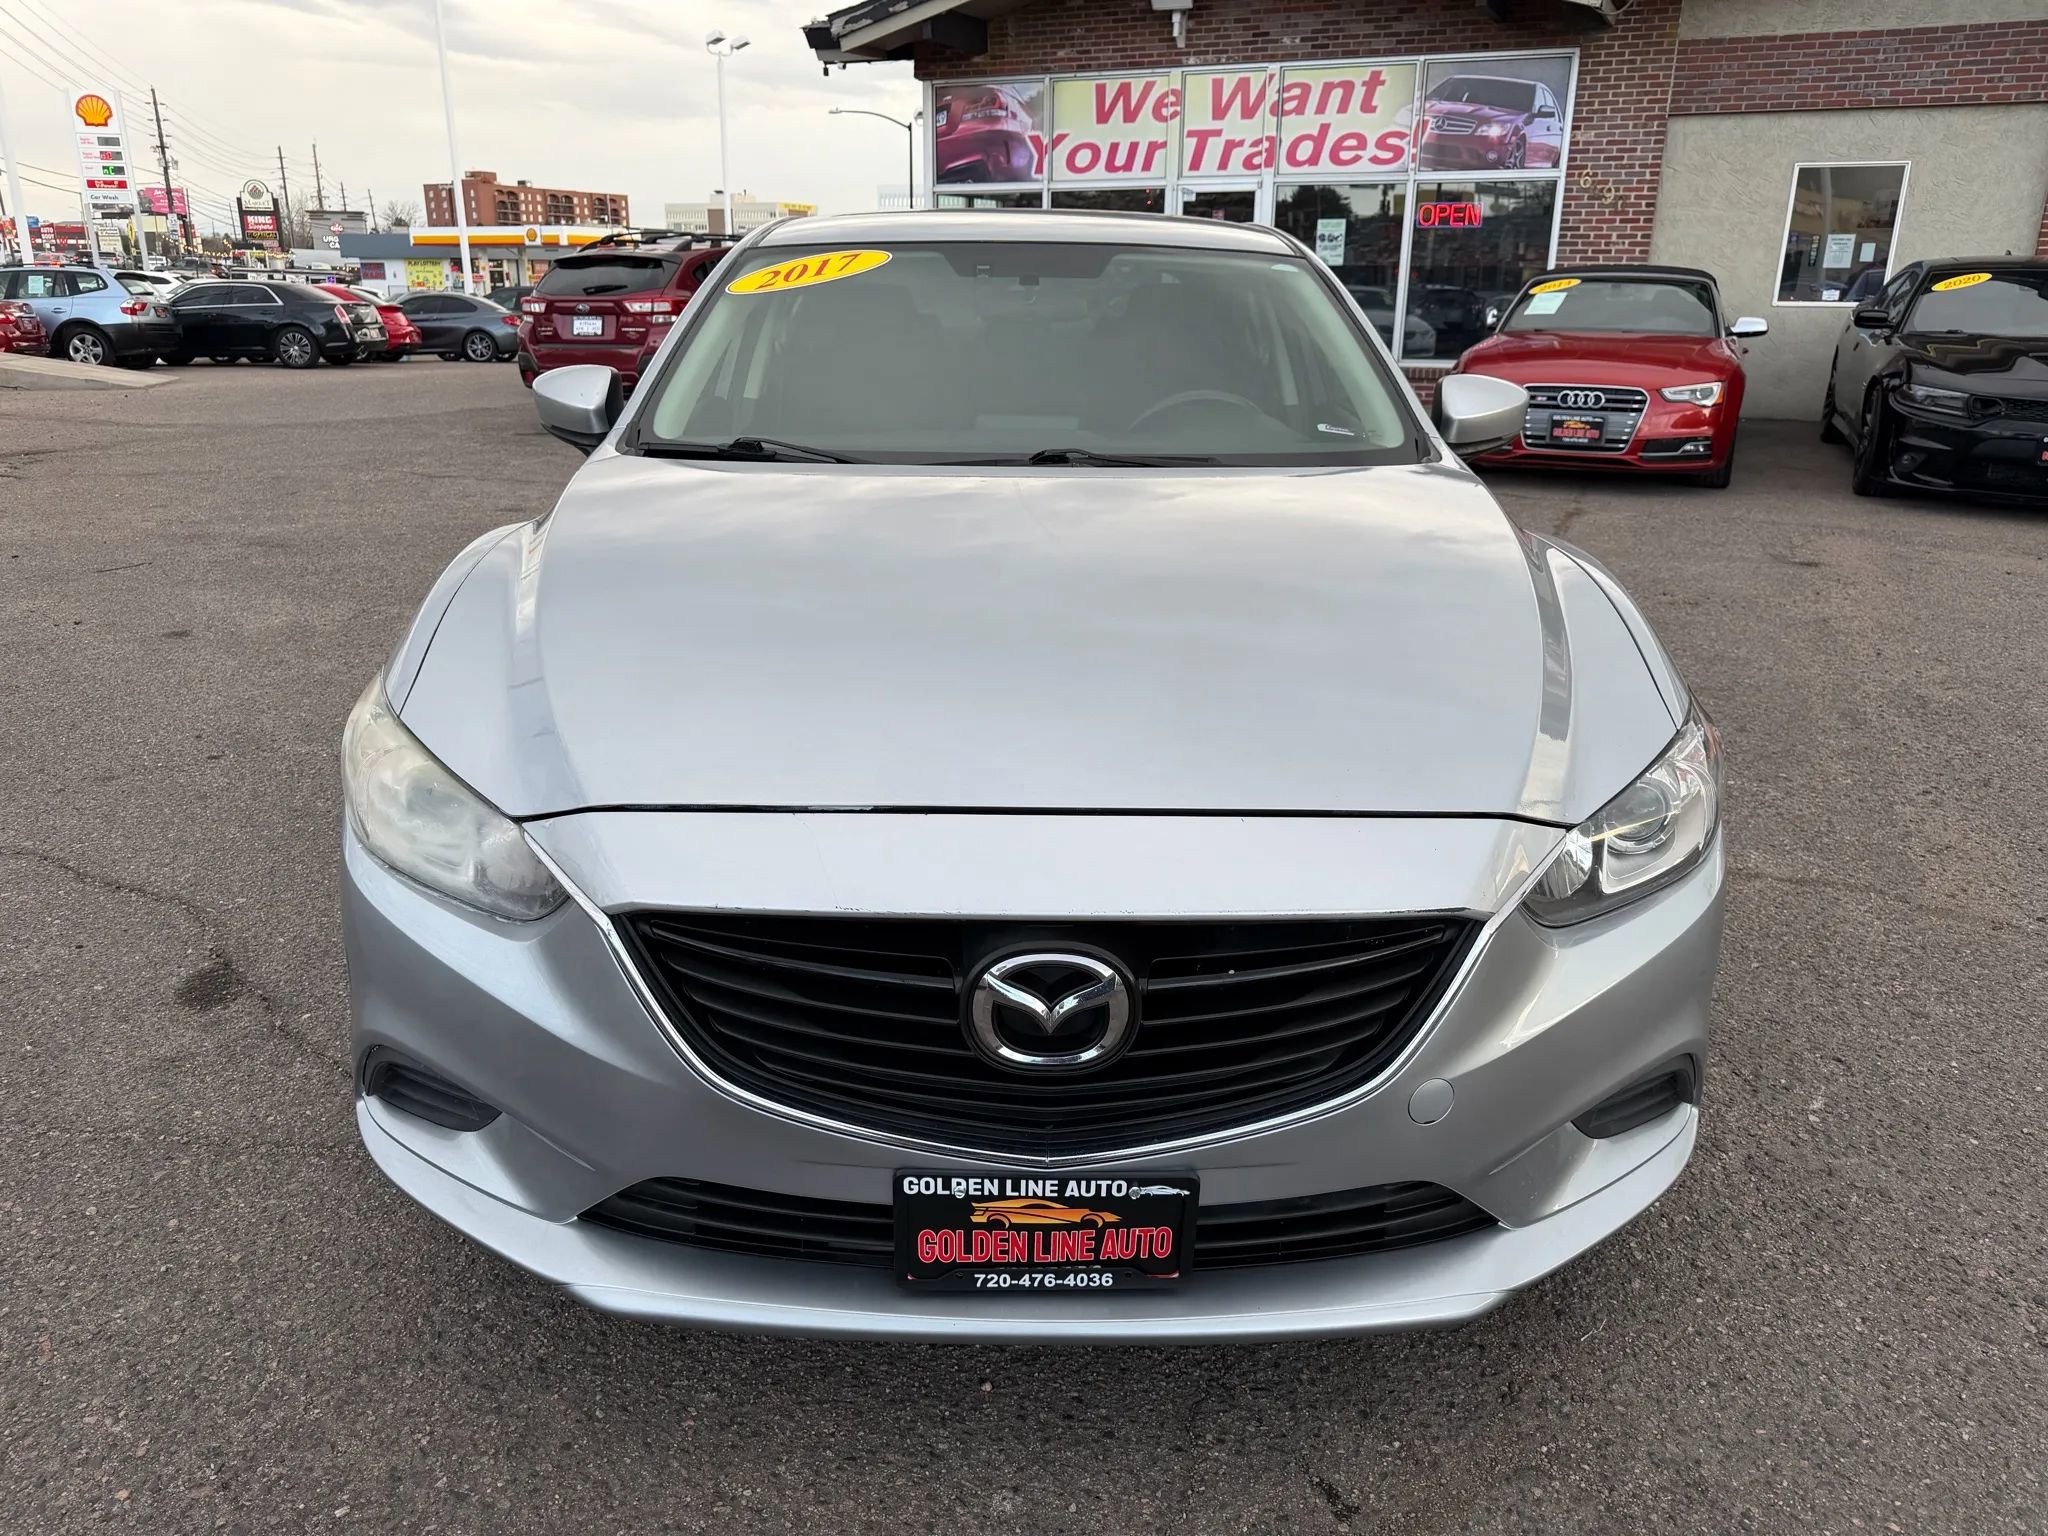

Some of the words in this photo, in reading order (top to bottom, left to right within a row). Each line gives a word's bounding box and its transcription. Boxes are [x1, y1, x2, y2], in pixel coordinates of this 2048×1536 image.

[1094, 80, 1181, 125] We
[1210, 69, 1387, 121] Want
[1027, 132, 1168, 175] Your
[1185, 118, 1430, 172] Trades!
[247, 215, 273, 224] KING
[1418, 203, 1481, 226] OPEN
[754, 252, 862, 290] 2017
[1943, 274, 1981, 289] 2020
[903, 1177, 999, 1196] GOLDEN
[1006, 1179, 1059, 1197] LINE
[1064, 1180, 1128, 1197] AUTO
[917, 1228, 1028, 1264] GOLDEN
[1034, 1230, 1096, 1263] LINE
[1100, 1226, 1173, 1260] AUTO
[974, 1273, 1114, 1288] 720-476-4036
